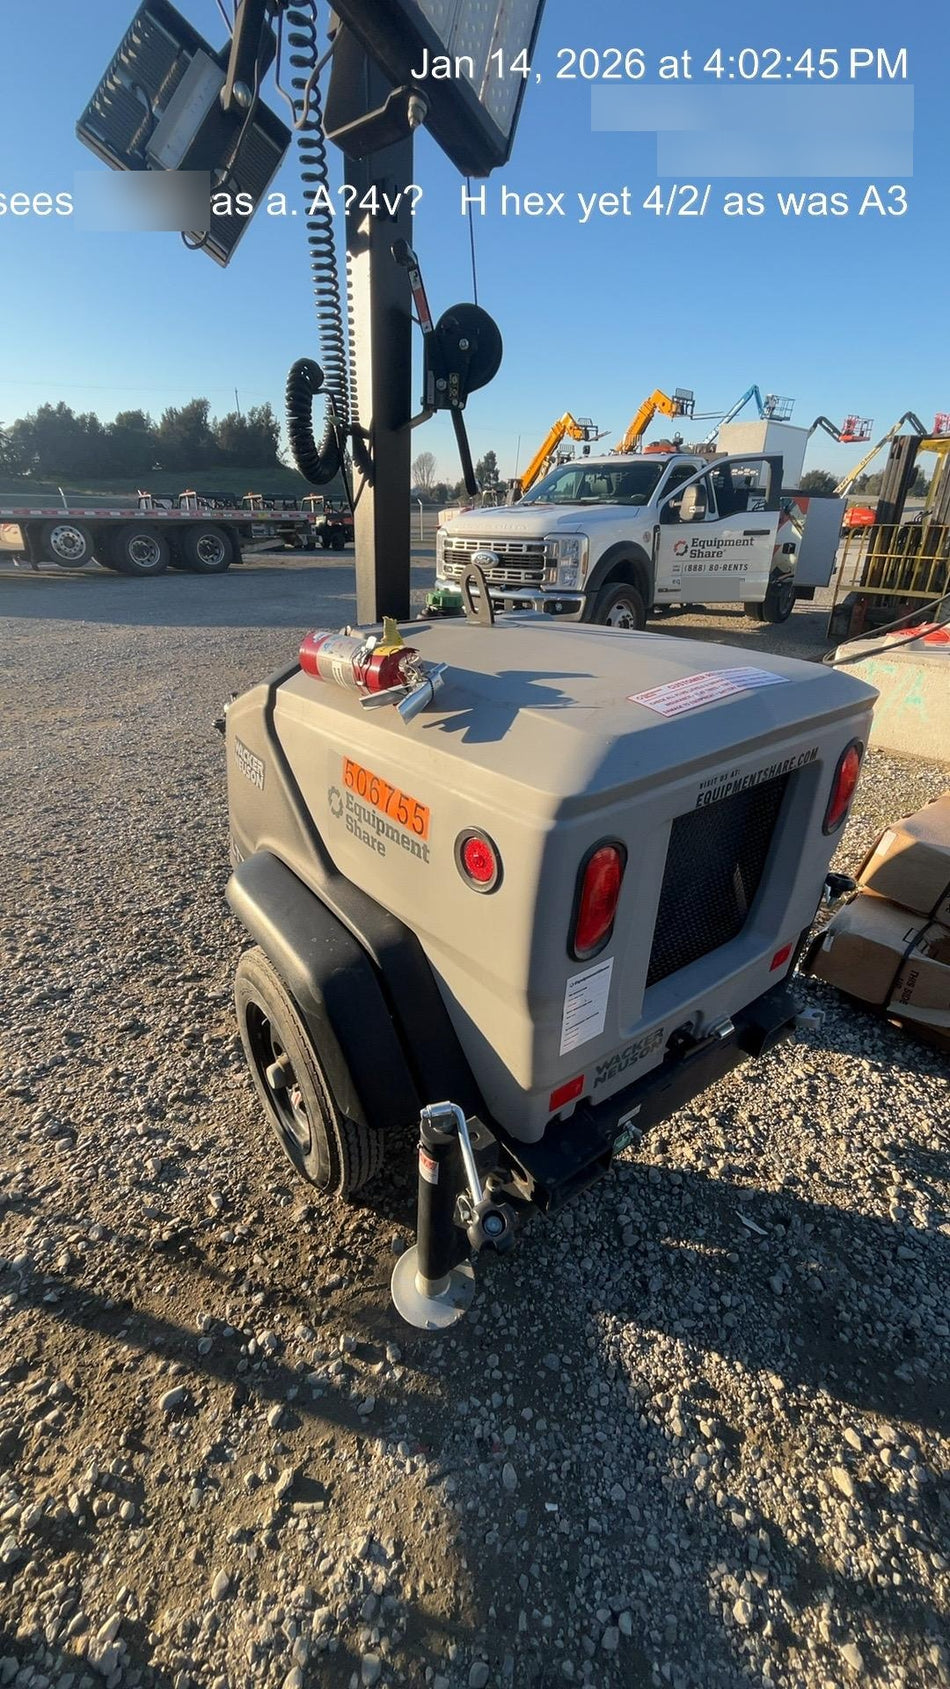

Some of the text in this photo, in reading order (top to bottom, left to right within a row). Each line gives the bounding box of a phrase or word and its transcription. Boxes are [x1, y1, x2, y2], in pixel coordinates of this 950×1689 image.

[689, 549, 724, 559] Share
[690, 536, 755, 549] Equipment
[684, 564, 706, 572] (888)
[708, 563, 749, 572] 80-RENTS
[344, 759, 426, 835] 506755
[695, 746, 819, 808] EQUIPMENTSHARE.COM
[345, 791, 430, 864] Equipment
[345, 813, 387, 857] Share
[592, 1039, 664, 1089] NEUSON
[595, 1026, 665, 1075] WACKER
